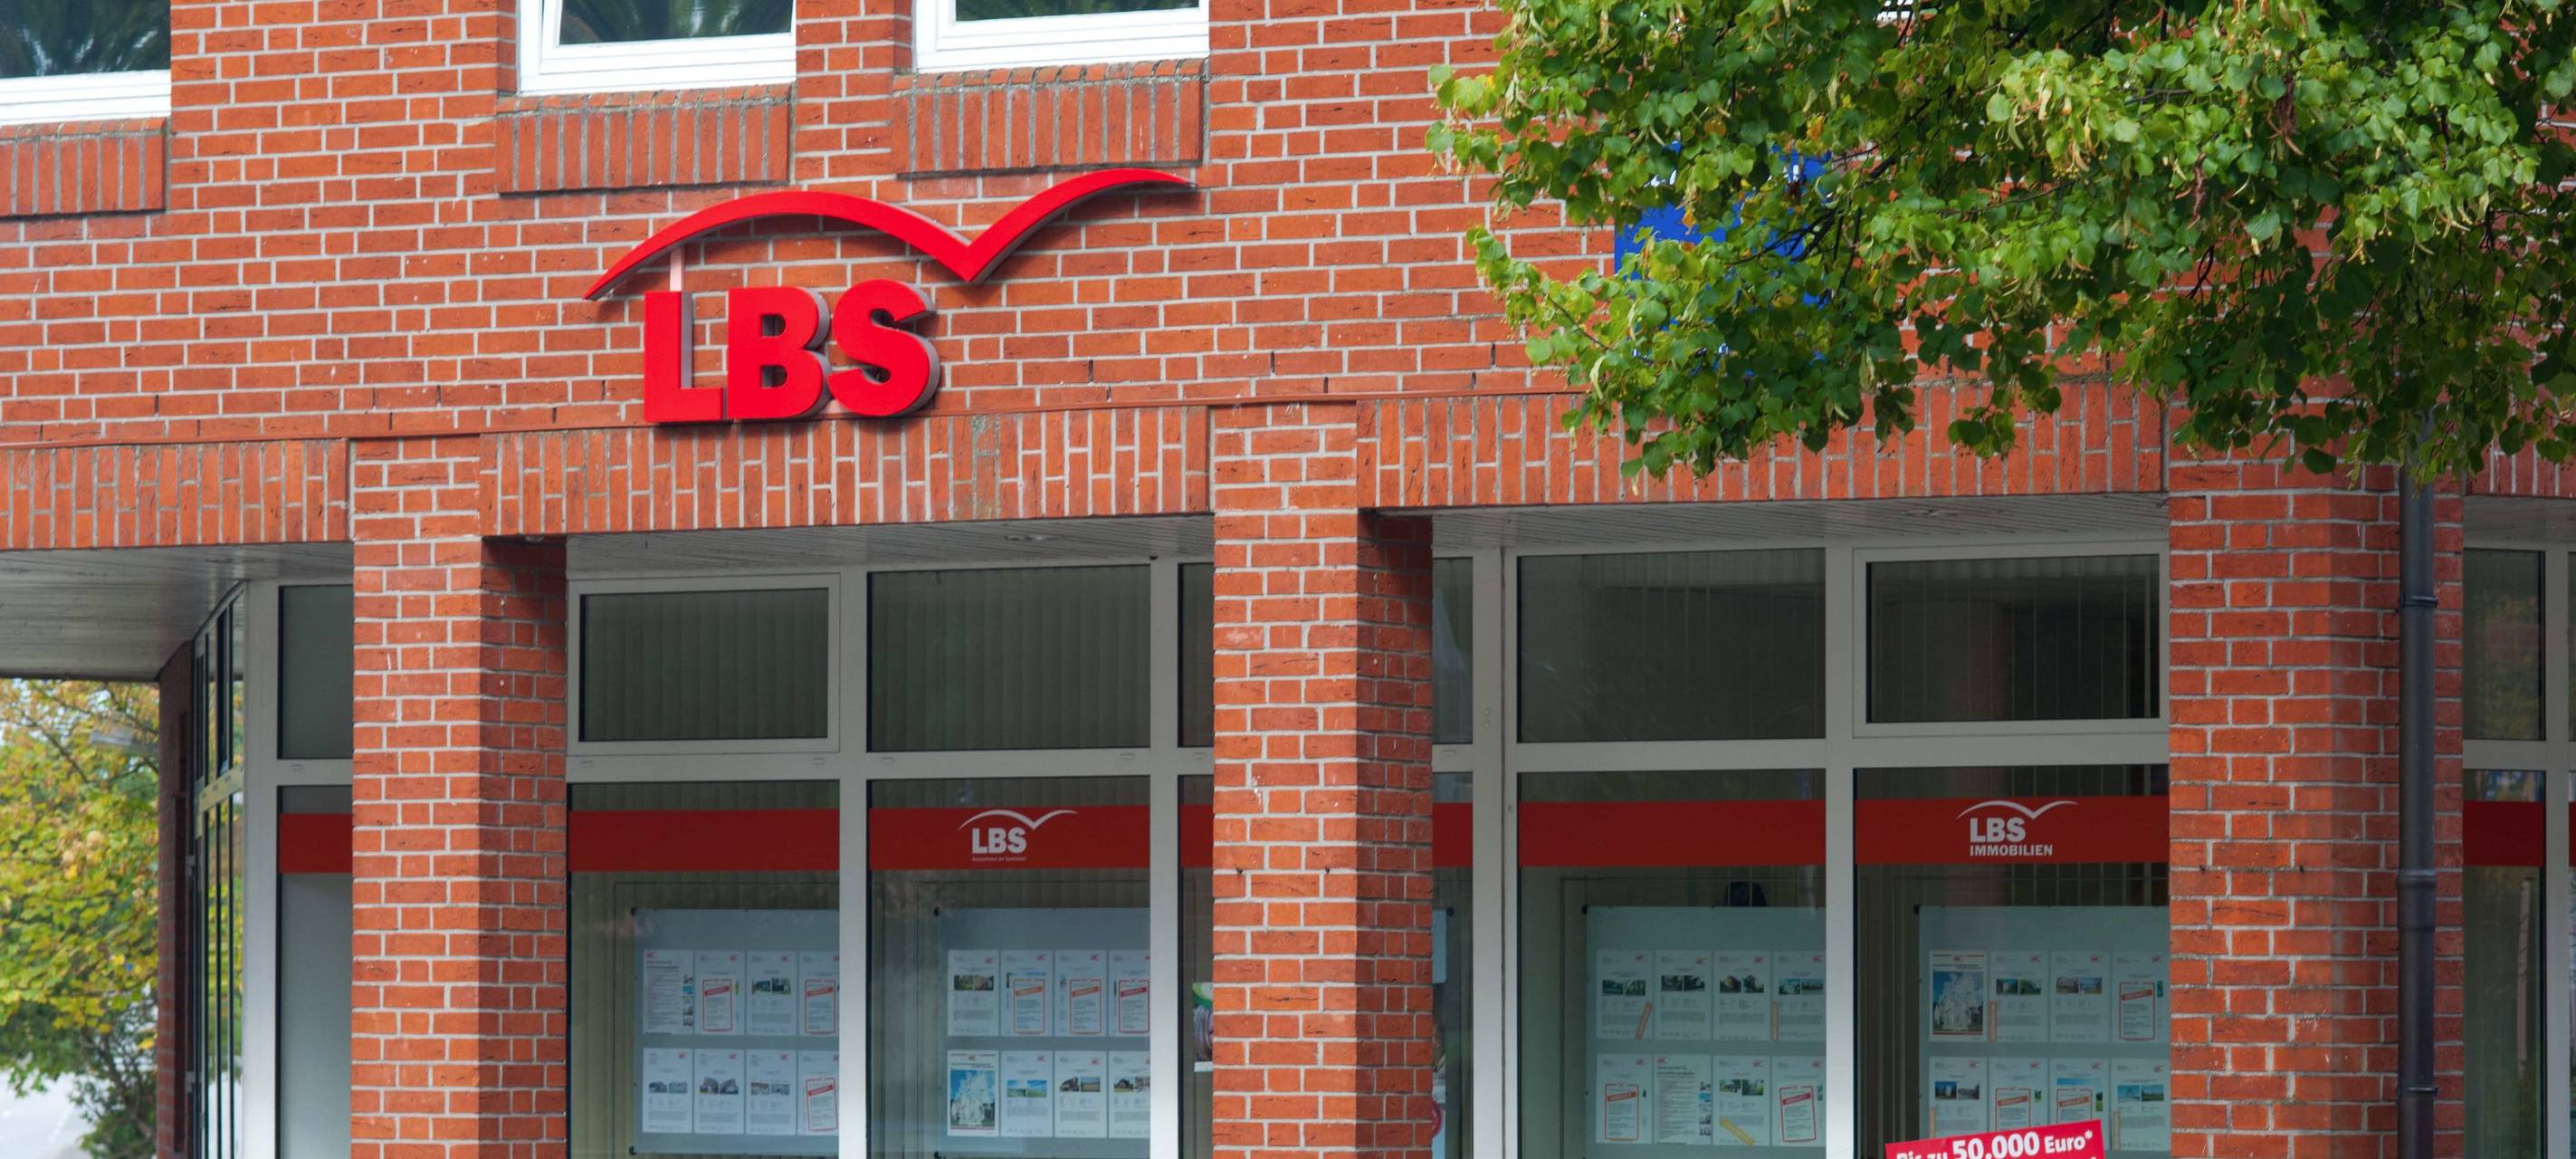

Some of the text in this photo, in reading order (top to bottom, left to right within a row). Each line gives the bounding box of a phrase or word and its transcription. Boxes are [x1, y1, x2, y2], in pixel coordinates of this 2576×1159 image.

[644, 280, 938, 423] LBS
[972, 827, 1026, 854] LBS
[1970, 818, 2026, 842] LBS
[1970, 845, 2053, 857] IMMOBILIEN
[1952, 1133, 2039, 1159] 50.000
